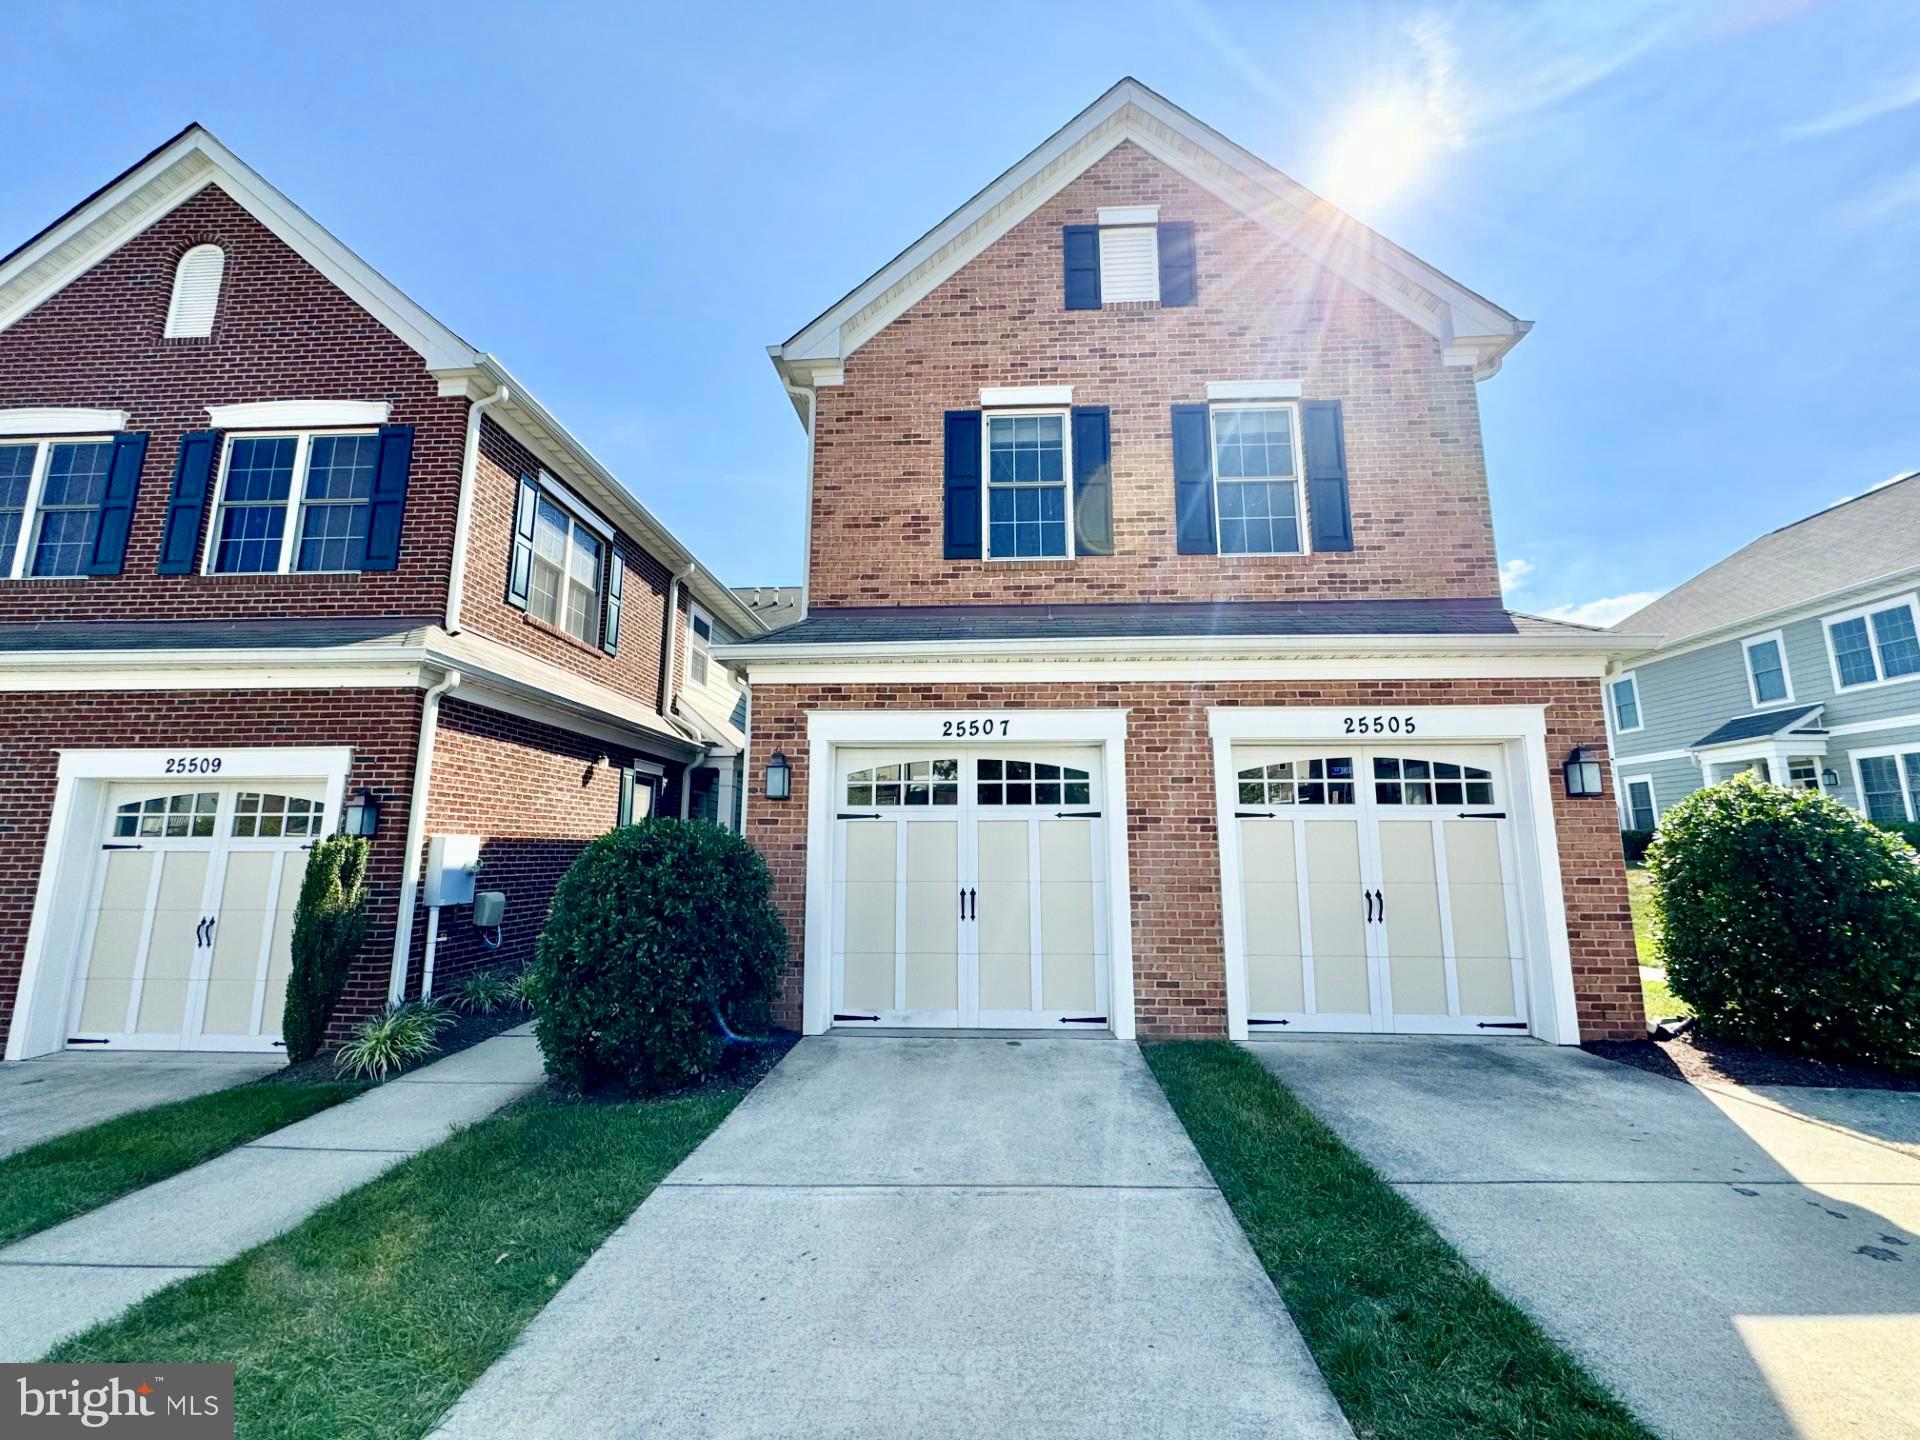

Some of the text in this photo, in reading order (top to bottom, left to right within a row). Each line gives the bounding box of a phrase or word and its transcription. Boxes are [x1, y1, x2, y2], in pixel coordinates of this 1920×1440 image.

[943, 719, 1010, 738] 25507
[1344, 716, 1416, 734] 25505
[165, 757, 222, 774] 25509
